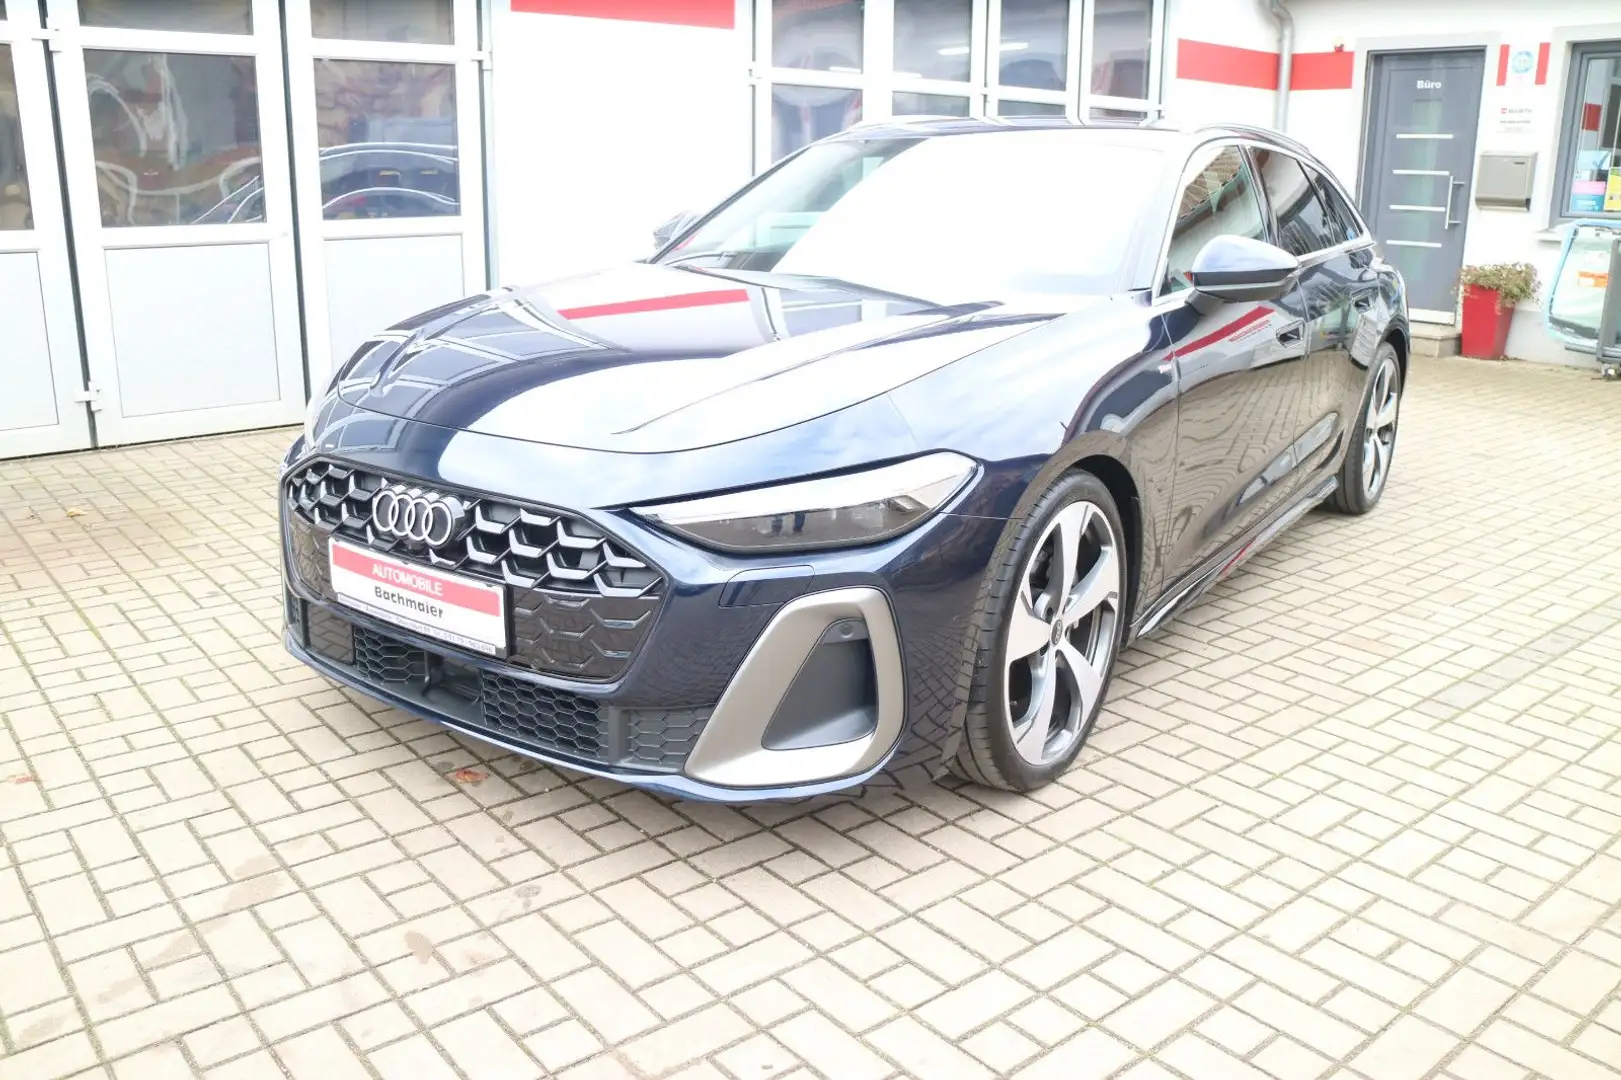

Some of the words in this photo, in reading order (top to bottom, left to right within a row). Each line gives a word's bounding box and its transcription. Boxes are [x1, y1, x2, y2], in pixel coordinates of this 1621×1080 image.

[1416, 79, 1442, 89] Büro
[372, 563, 445, 596] AUTOMOBILE
[374, 586, 444, 618] Bachmaier
